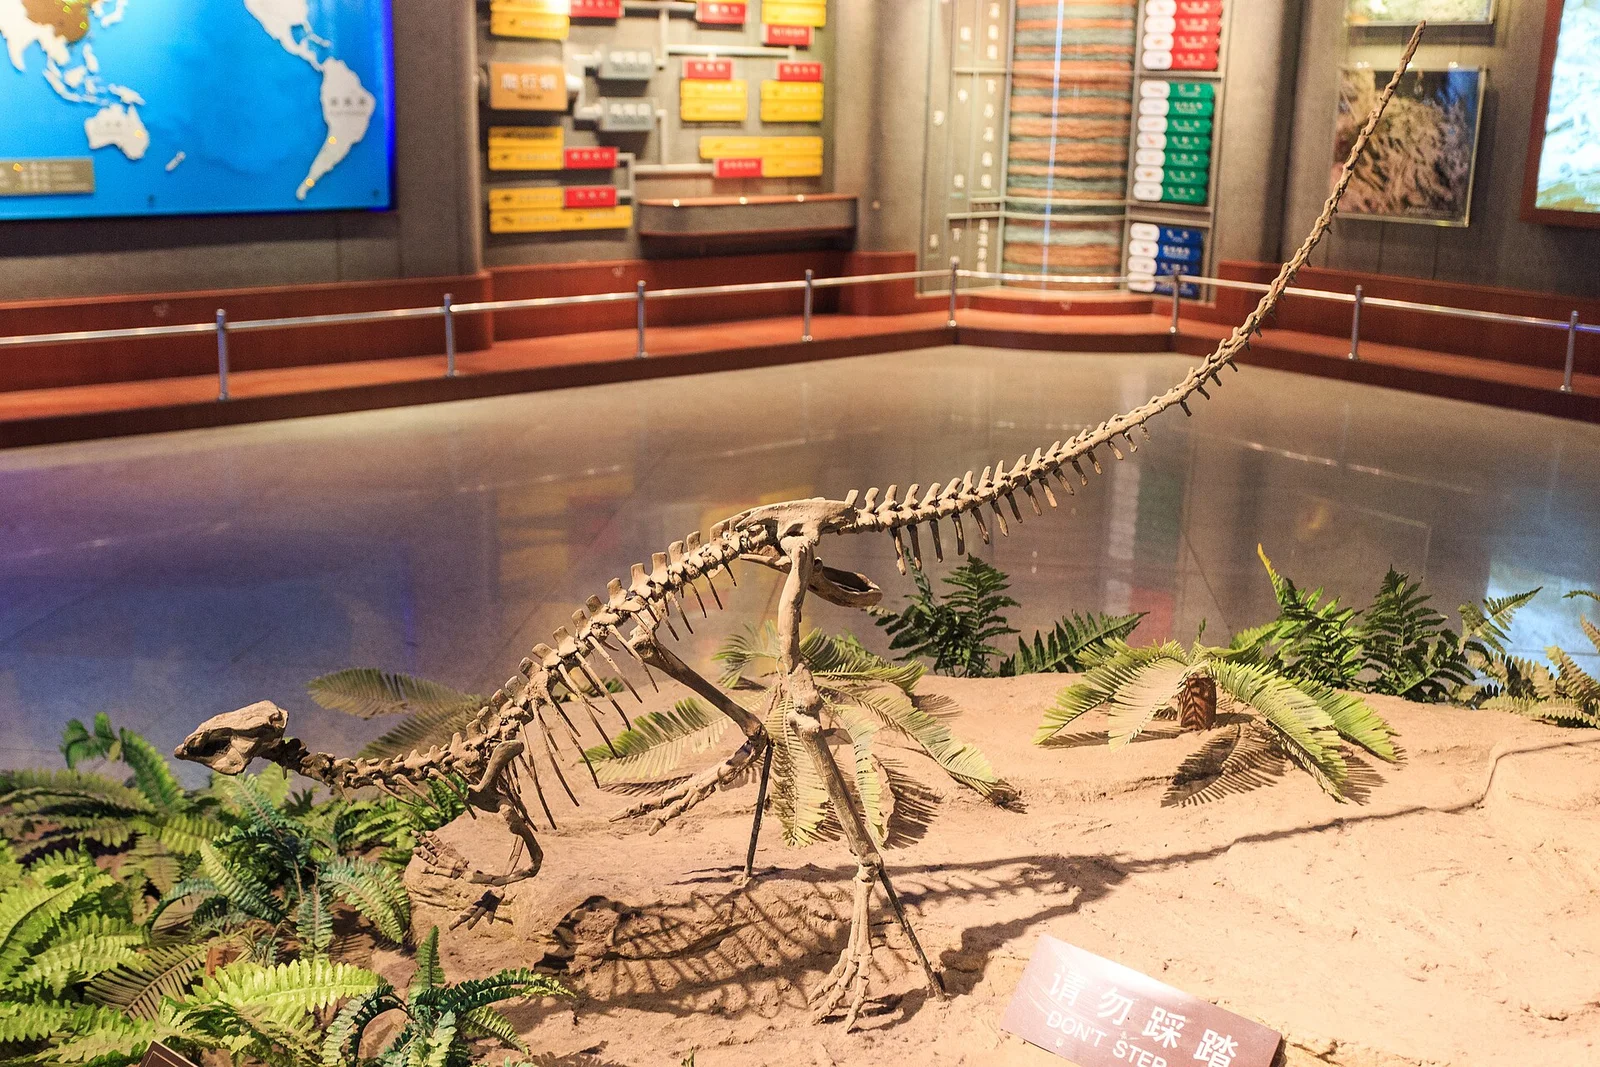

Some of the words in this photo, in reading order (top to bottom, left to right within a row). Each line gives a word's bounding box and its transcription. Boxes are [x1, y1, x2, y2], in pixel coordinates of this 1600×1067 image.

[1046, 1010, 1108, 1048] DON'T
[1049, 964, 1239, 1067] 请勿踩踏
